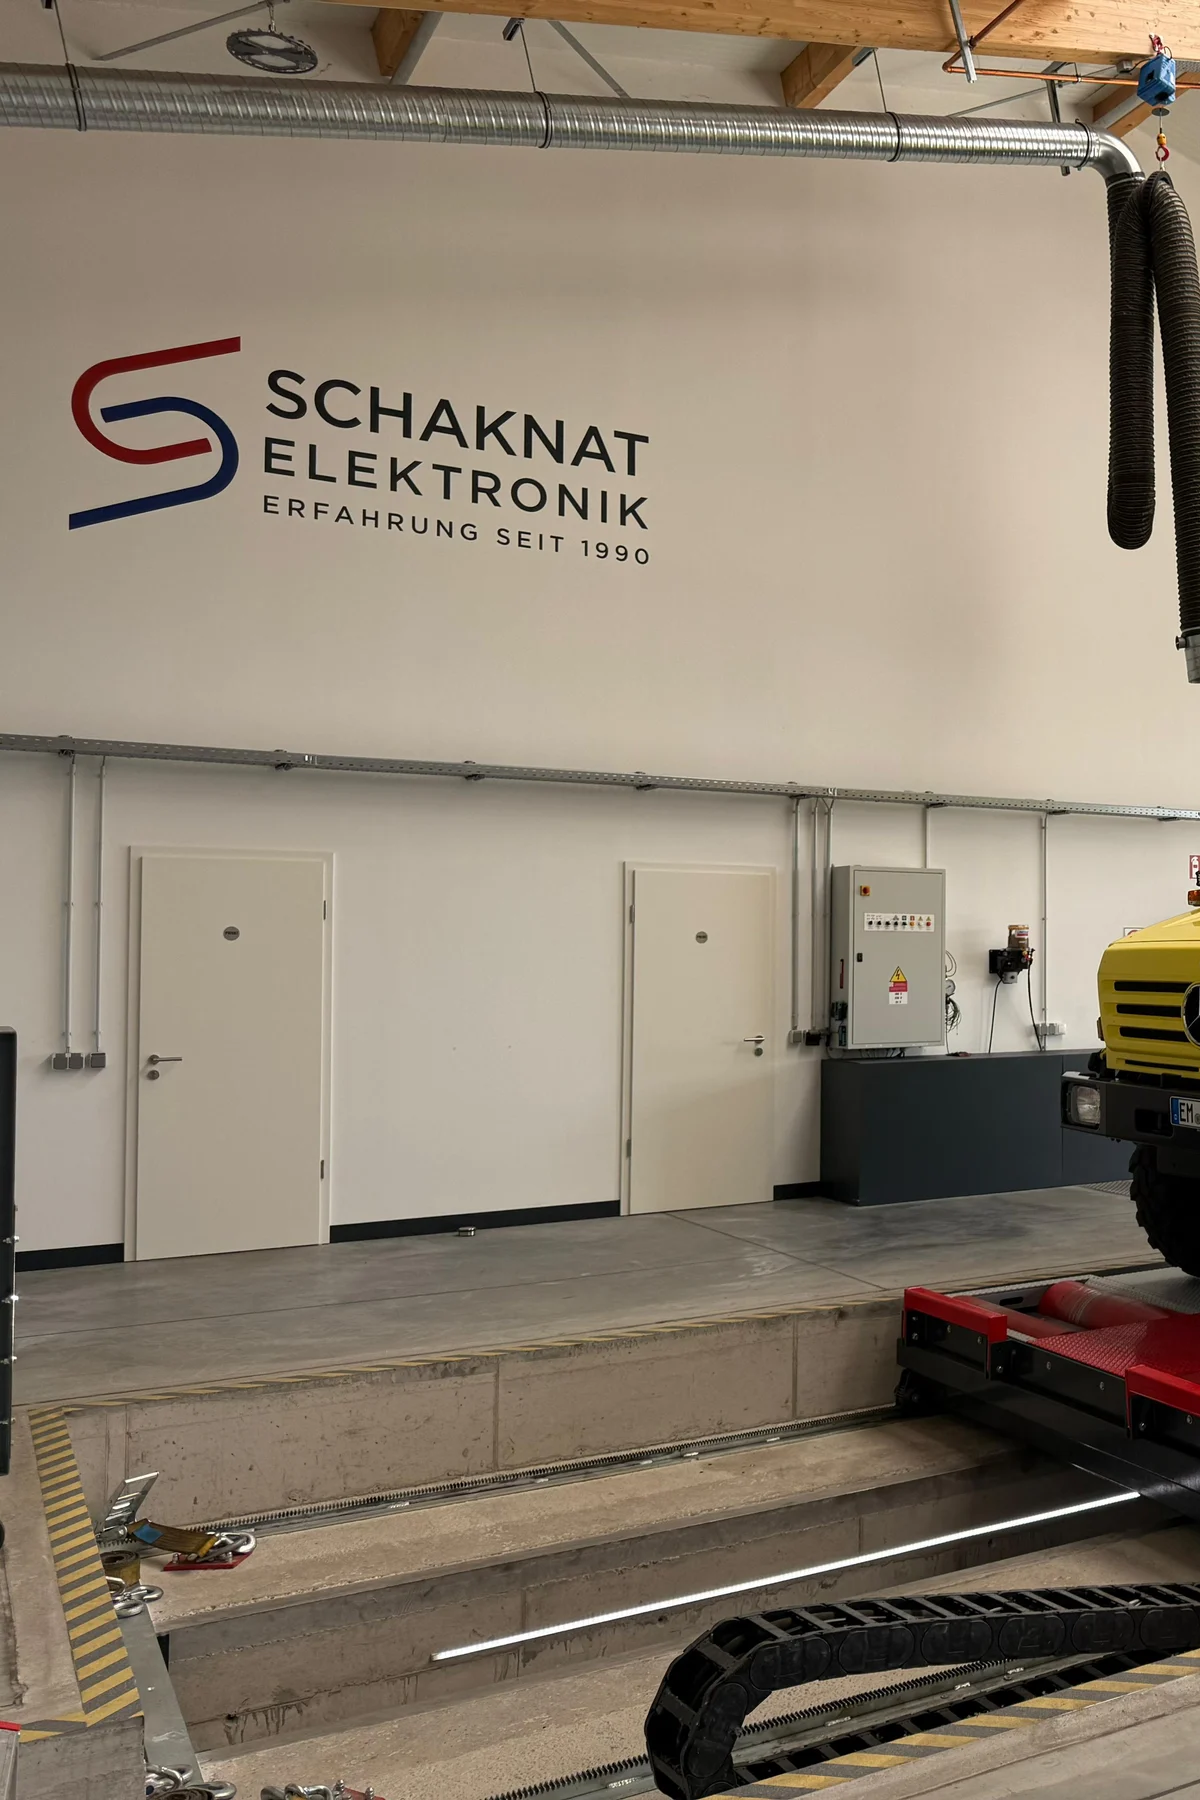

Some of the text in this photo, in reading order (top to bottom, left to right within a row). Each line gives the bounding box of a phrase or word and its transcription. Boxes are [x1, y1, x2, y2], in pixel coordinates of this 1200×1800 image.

[265, 369, 650, 477] SCHAKNAT
[263, 436, 650, 530] ELEKTRONIK
[263, 494, 650, 565] ERFAHRUNG SEIT 1990
[1179, 1102, 1194, 1124] EM
